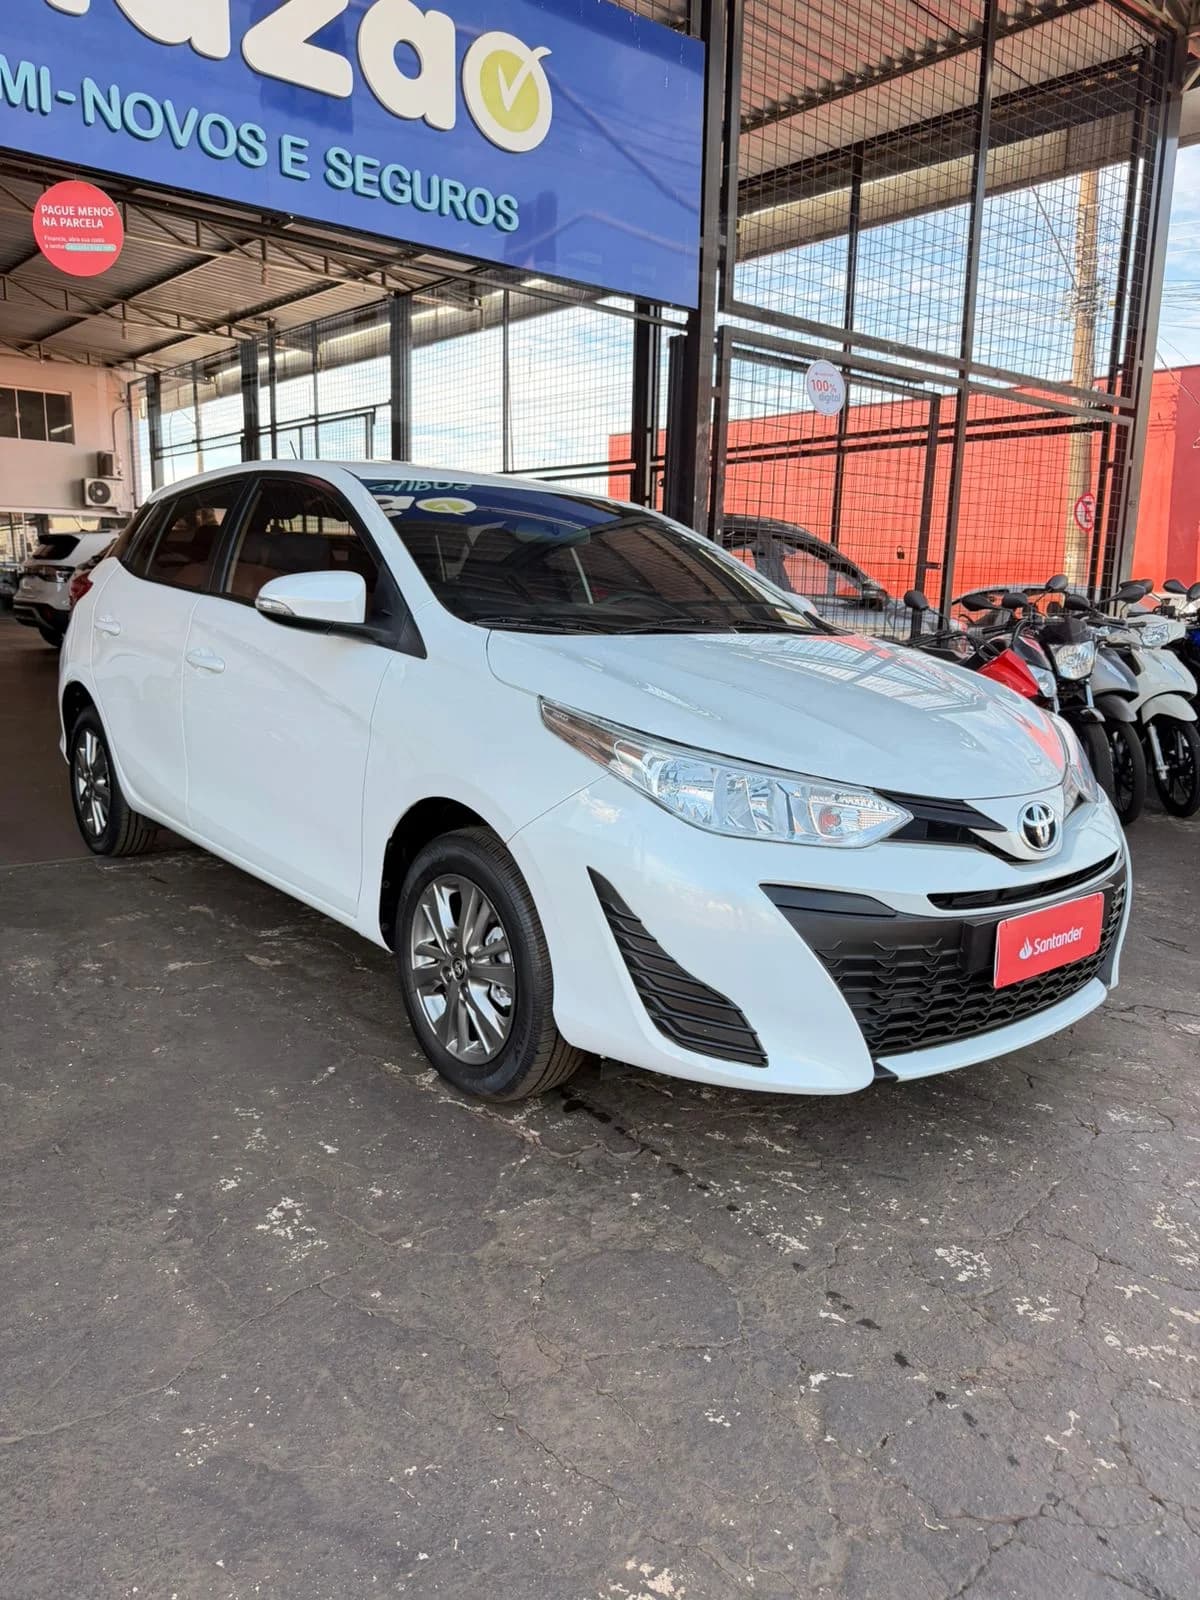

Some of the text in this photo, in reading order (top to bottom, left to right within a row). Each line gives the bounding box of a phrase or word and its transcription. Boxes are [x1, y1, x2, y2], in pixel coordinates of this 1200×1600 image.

[280, 134, 311, 180] E
[324, 146, 520, 233] SEGUROS
[41, 204, 115, 217] PAGUE MENOS
[42, 216, 104, 229] NA PARCELA
[811, 379, 837, 394] 100%
[1033, 926, 1083, 955] Santander
